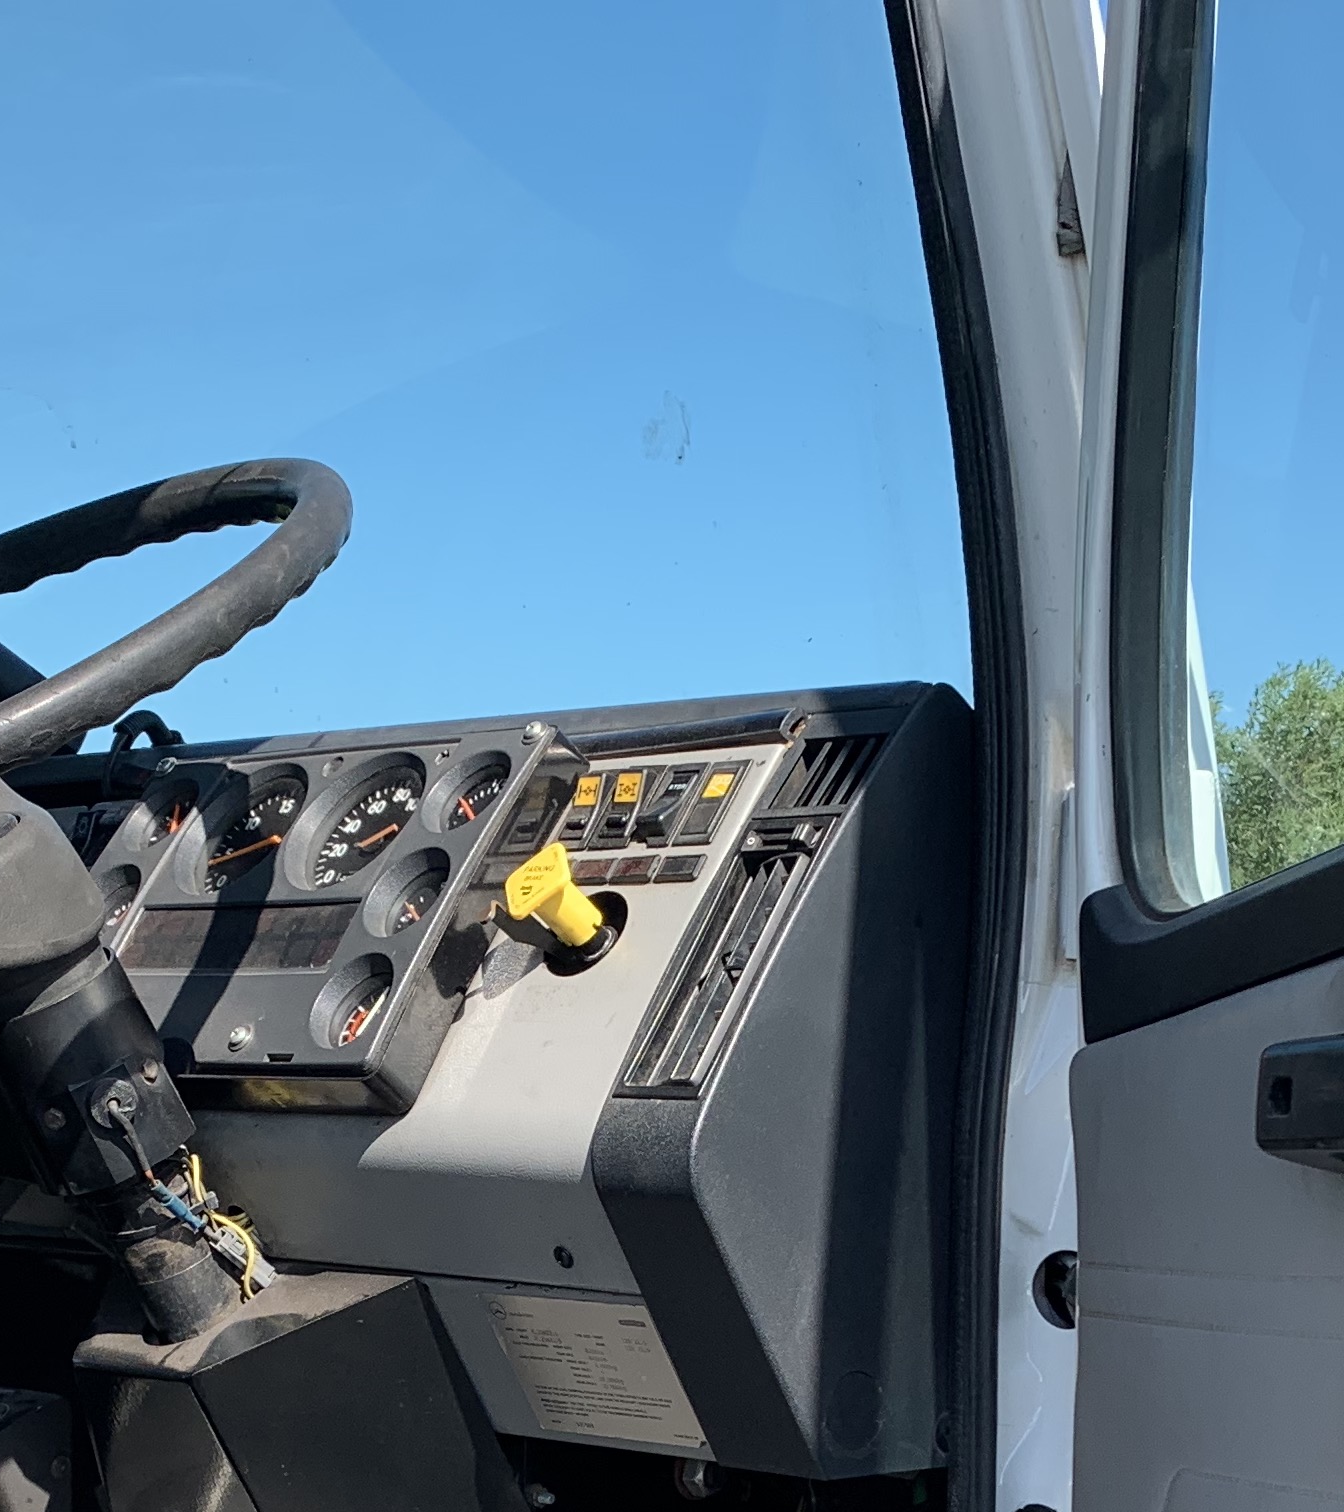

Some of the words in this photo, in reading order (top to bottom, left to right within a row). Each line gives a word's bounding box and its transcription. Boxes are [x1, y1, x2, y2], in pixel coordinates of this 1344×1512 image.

[278, 799, 296, 814] 15
[367, 800, 387, 814] 60
[244, 816, 262, 831] 10
[328, 843, 348, 857] 20
[216, 875, 227, 888] 0
[323, 869, 335, 883] 0
